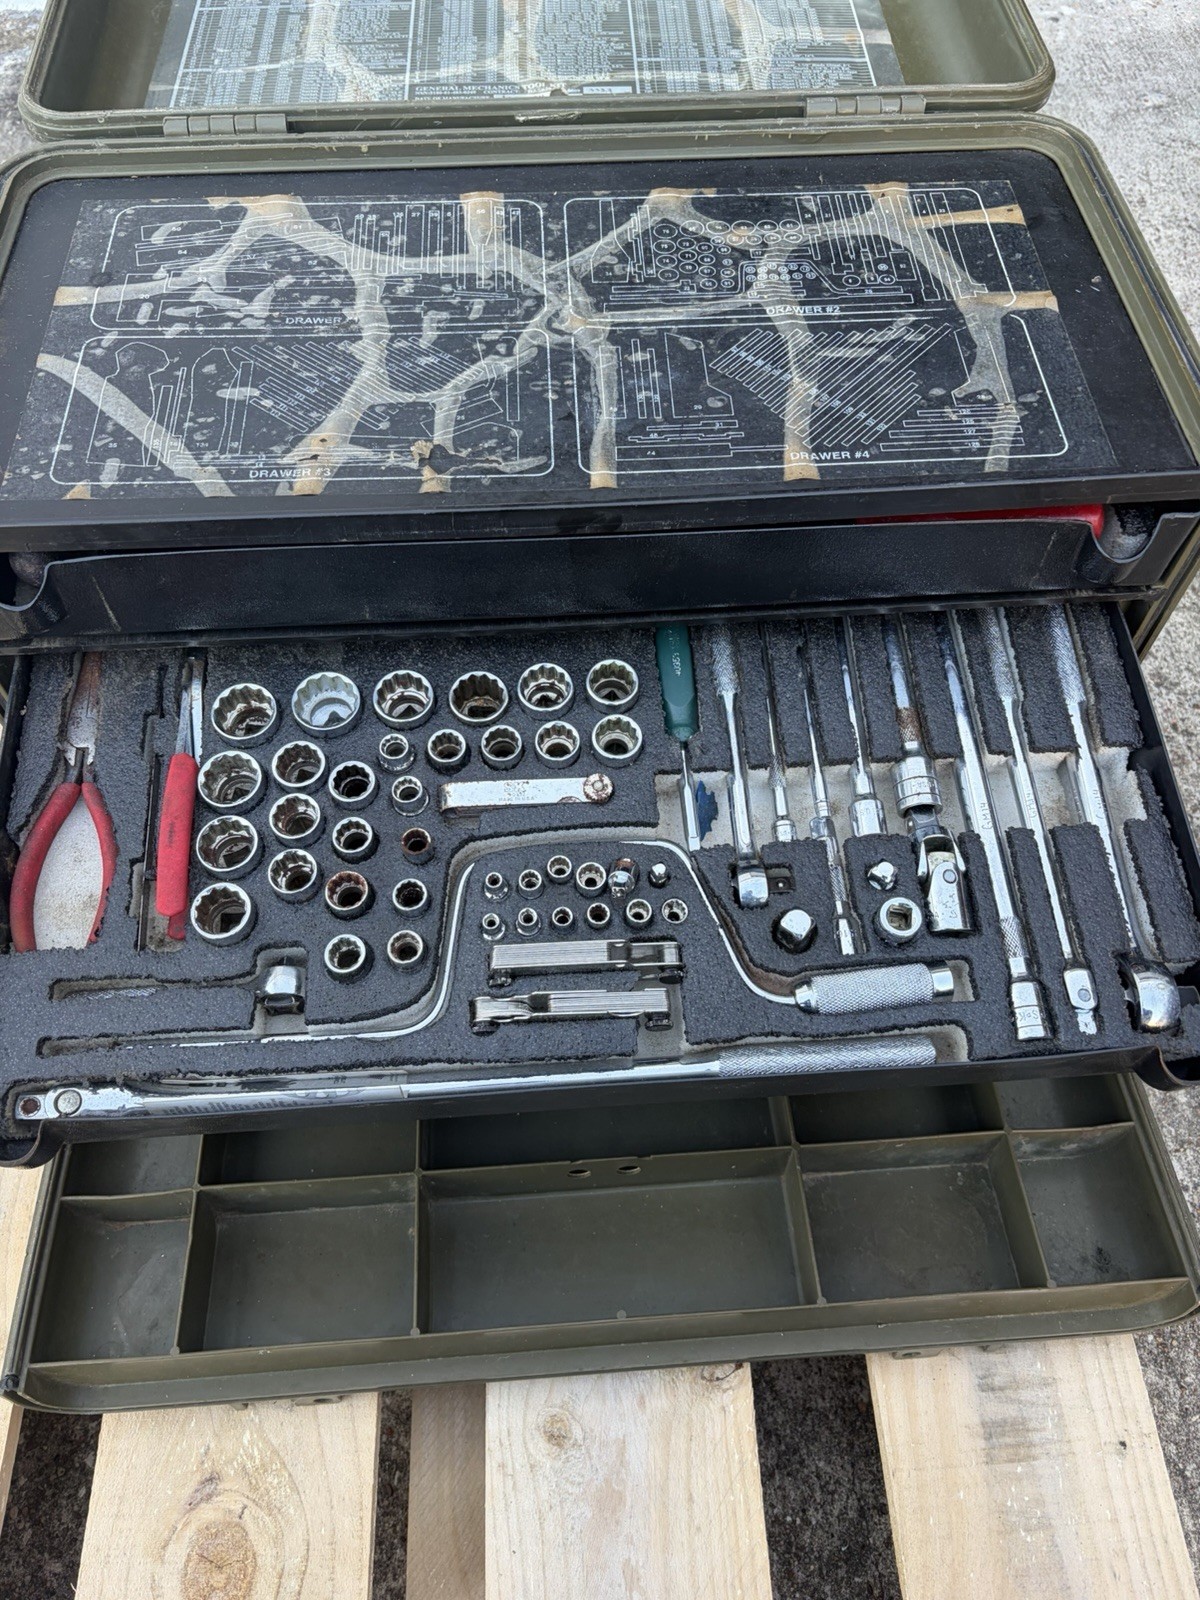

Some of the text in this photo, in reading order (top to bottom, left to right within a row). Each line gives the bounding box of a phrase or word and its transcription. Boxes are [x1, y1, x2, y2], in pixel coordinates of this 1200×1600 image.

[766, 305, 841, 315] DRAWER #2
[285, 316, 343, 325] DRAWER
[790, 450, 870, 461] DRAWER #4
[250, 467, 331, 479] DRAWER #3
